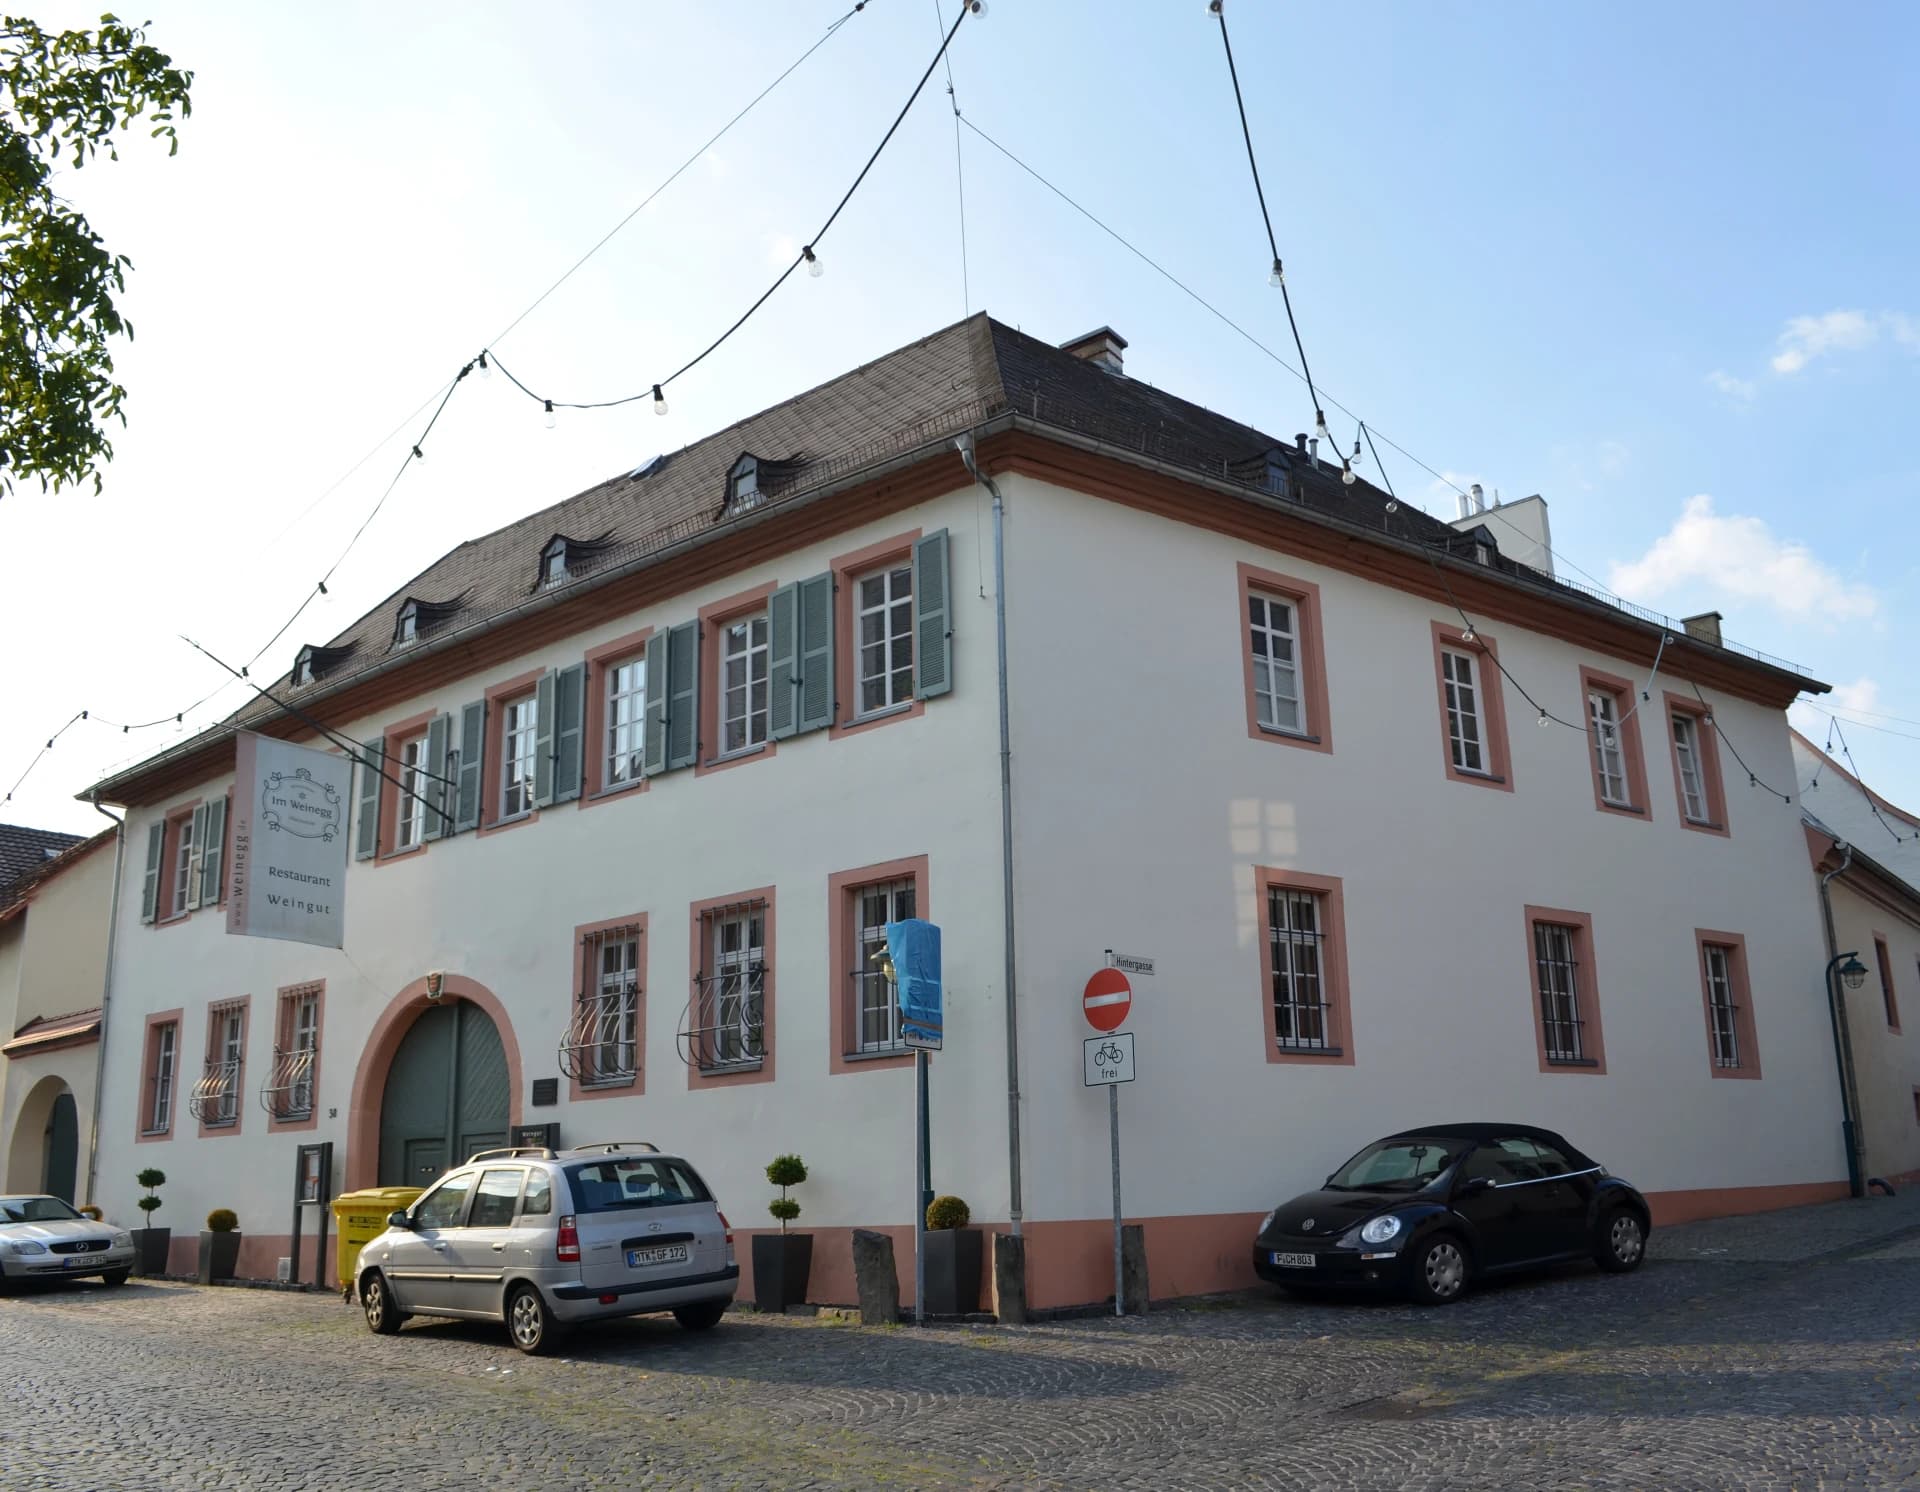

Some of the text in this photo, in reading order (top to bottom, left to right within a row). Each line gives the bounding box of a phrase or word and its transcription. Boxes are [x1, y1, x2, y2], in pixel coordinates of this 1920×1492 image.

[271, 795, 333, 820] Im Weinegg
[268, 866, 331, 888] Restaurant
[267, 893, 330, 915] Weingut
[1116, 956, 1153, 972] Hintergasse
[1101, 1066, 1118, 1079] frei
[634, 1247, 685, 1262] MTK GF 172
